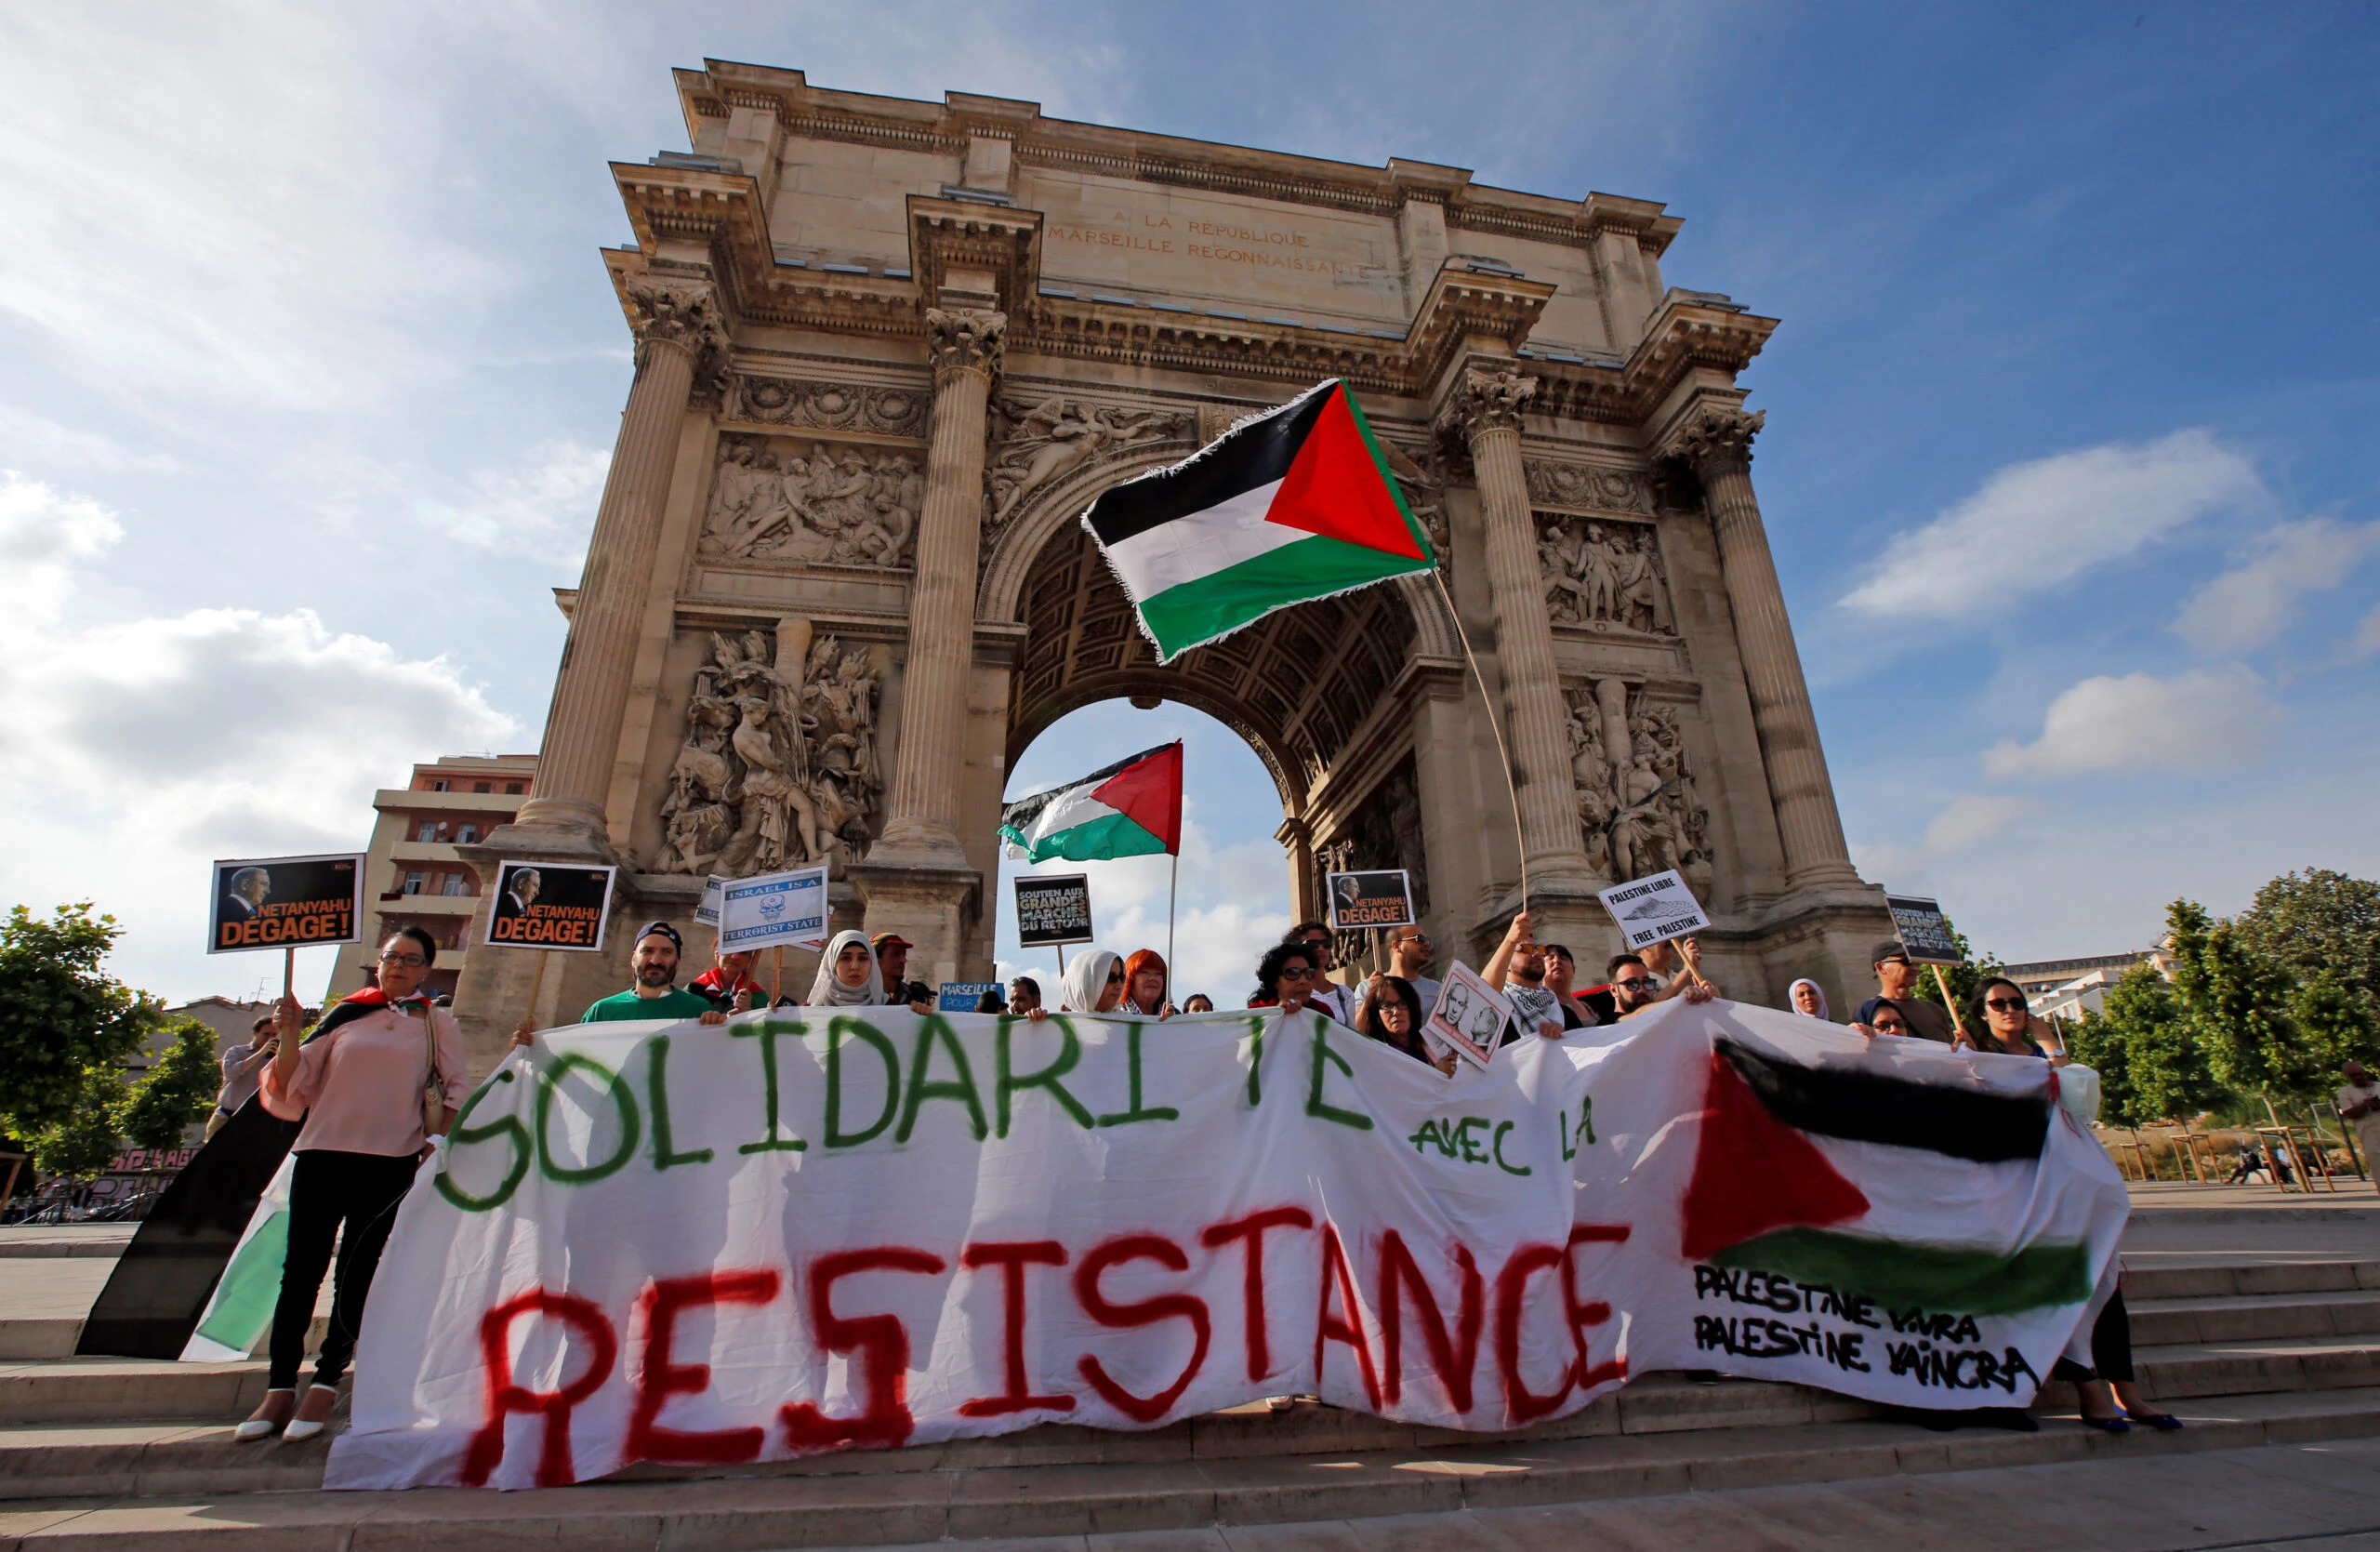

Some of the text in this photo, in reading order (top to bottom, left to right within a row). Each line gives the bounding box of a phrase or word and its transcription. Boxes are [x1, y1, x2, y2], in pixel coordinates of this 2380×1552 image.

[1144, 215, 1171, 229] LA
[1048, 226, 1174, 253] MARSEILLE
[729, 883, 784, 898] ISRAEL
[788, 881, 803, 889] IS
[807, 878, 818, 886] A
[1019, 887, 1085, 899] SOUTIEN AUX
[1608, 877, 1676, 905] PALESTINE LIBRE
[258, 898, 351, 918] NETANYAHU
[1019, 895, 1086, 910] GRANDES
[1355, 896, 1407, 908] NETANYAHU
[525, 904, 601, 920] NETANYAHU
[1021, 905, 1087, 921] MARCHES
[723, 917, 822, 940] TERRORIST STATE
[1021, 917, 1089, 931] DU RETOUR
[1633, 915, 1700, 944] FREE PALESTINE
[946, 997, 972, 1008] POUR
[1408, 1094, 1596, 1176] AVEC LA
[459, 1206, 1633, 1488] RESISTANCE
